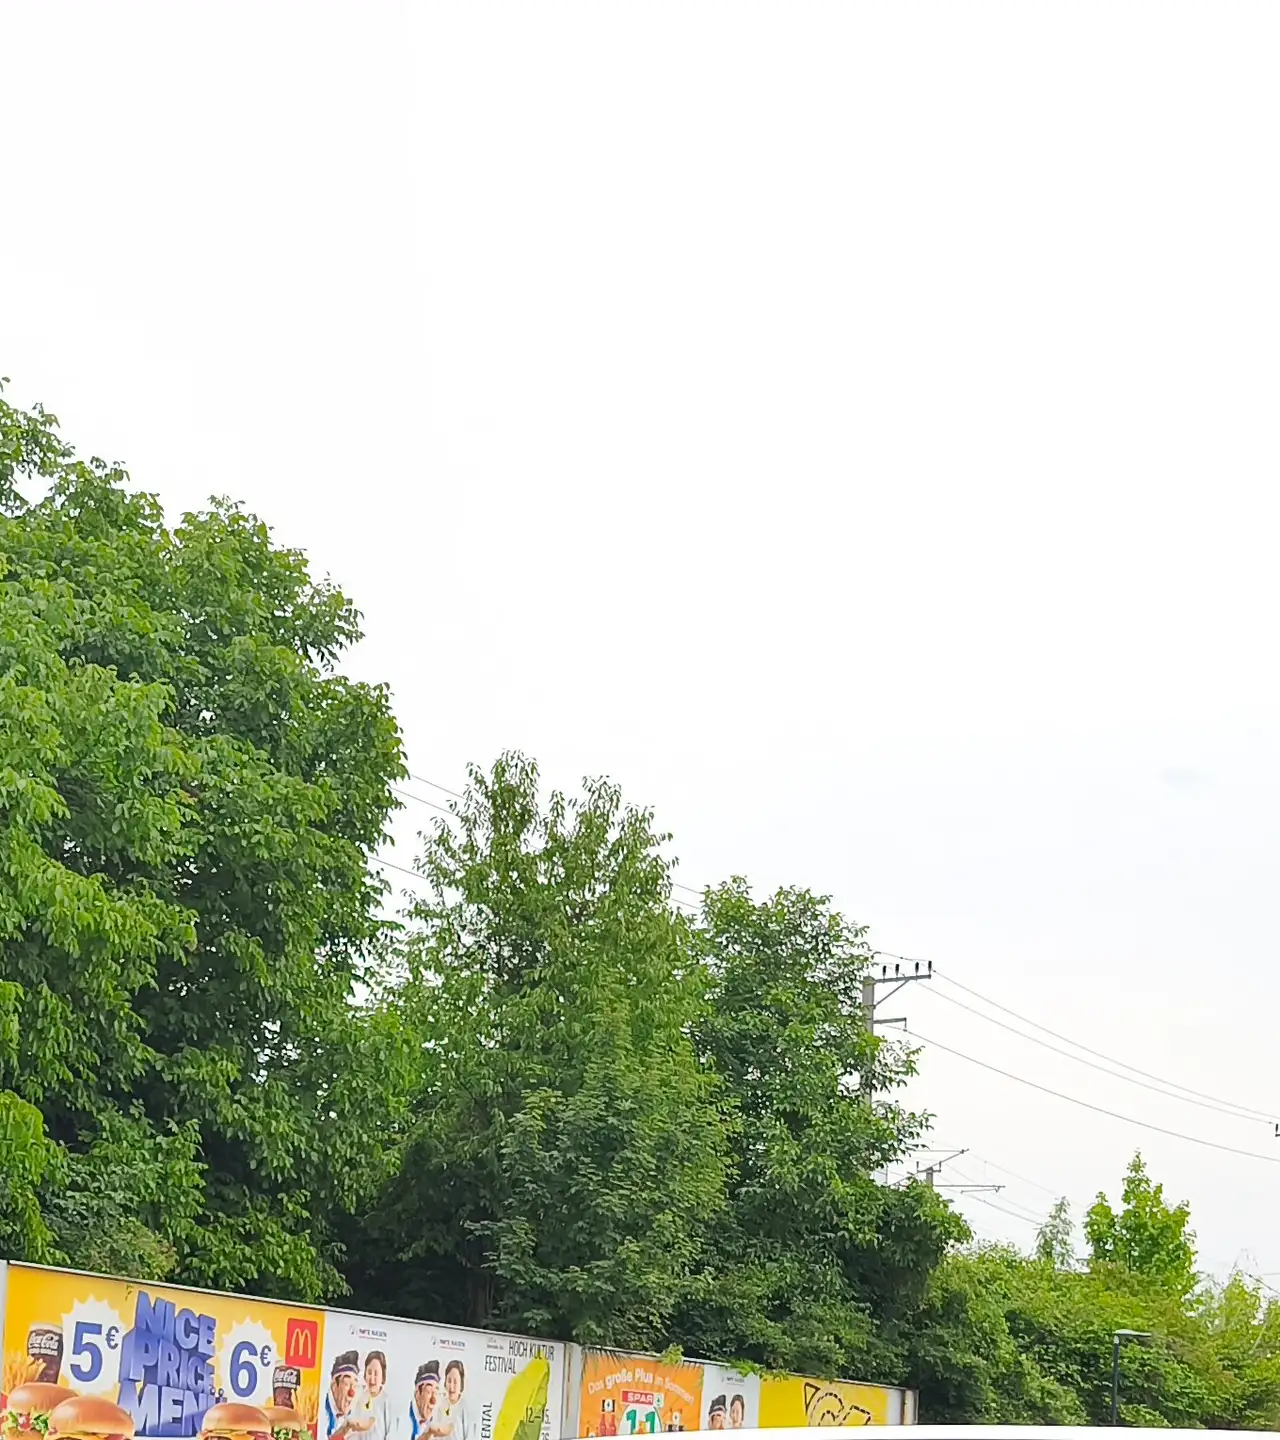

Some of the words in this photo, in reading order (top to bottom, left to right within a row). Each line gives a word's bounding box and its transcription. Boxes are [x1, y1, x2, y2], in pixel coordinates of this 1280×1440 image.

[135, 1290, 217, 1358] NICE
[509, 1340, 528, 1357] HOCH
[529, 1343, 555, 1362] KULTUR
[70, 1321, 103, 1383] 5
[105, 1326, 120, 1349] €
[130, 1340, 215, 1395] PRICE
[230, 1340, 258, 1398] 6
[260, 1345, 272, 1367] €
[485, 1355, 517, 1375] FESTIVAL
[627, 1392, 653, 1404] SPAR
